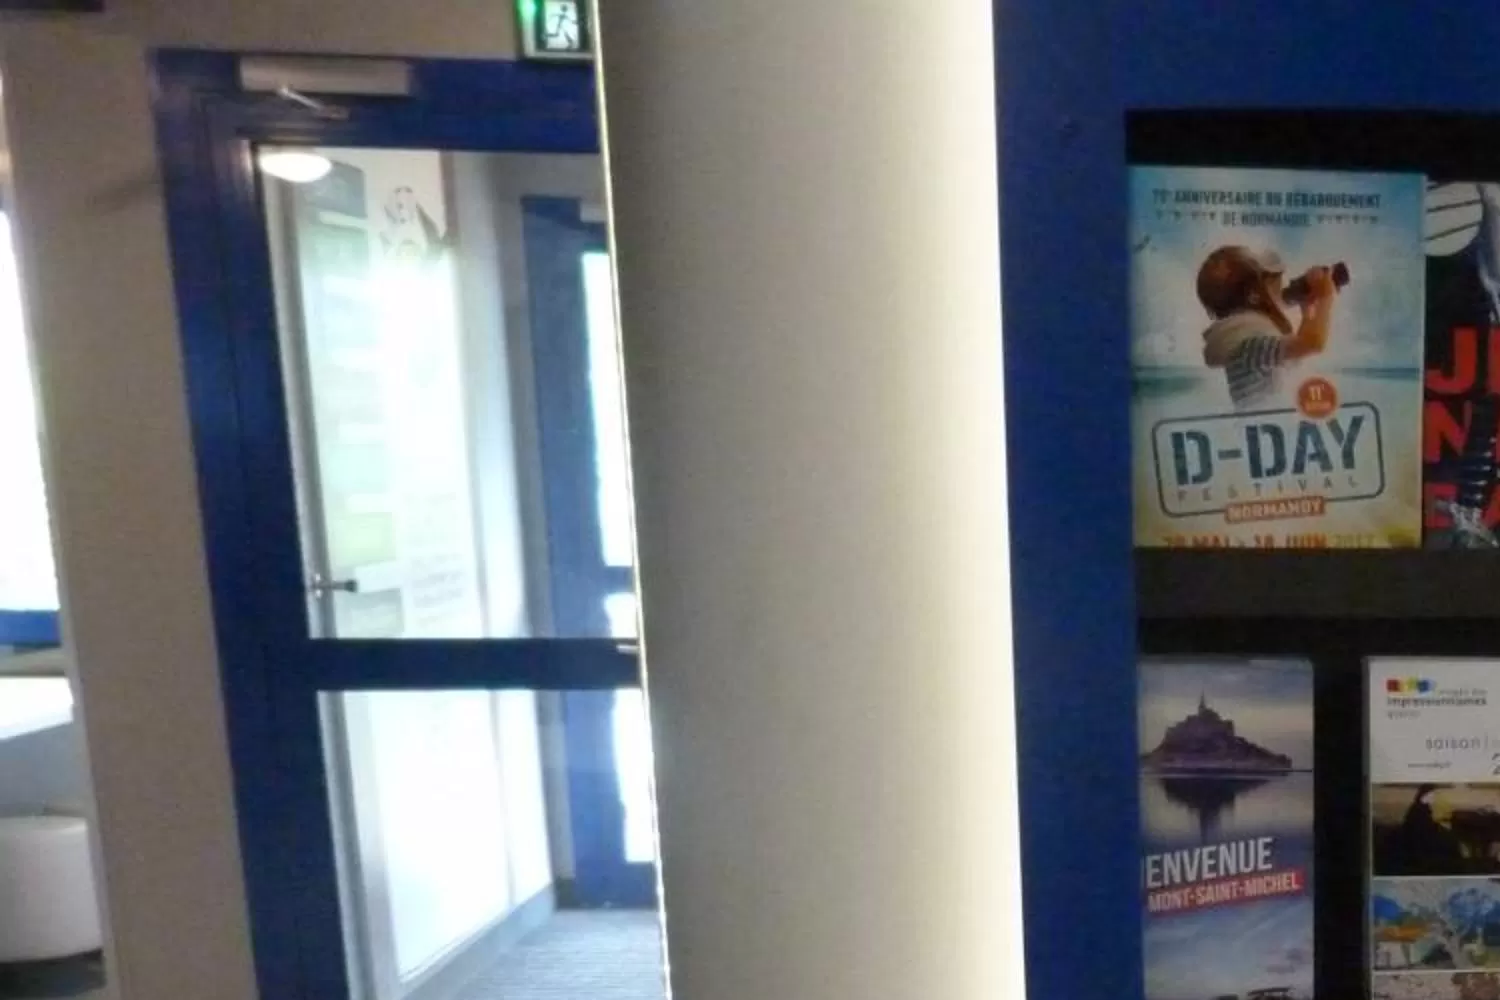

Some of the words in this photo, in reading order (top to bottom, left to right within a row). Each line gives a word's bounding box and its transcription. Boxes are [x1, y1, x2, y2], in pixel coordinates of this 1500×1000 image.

[1171, 415, 1365, 485] D-DAY
[1178, 475, 1360, 501] FESTIVAL
[1228, 499, 1322, 521] NORMANDY
[1148, 873, 1300, 912] MONT-SAINT-MICHEL
